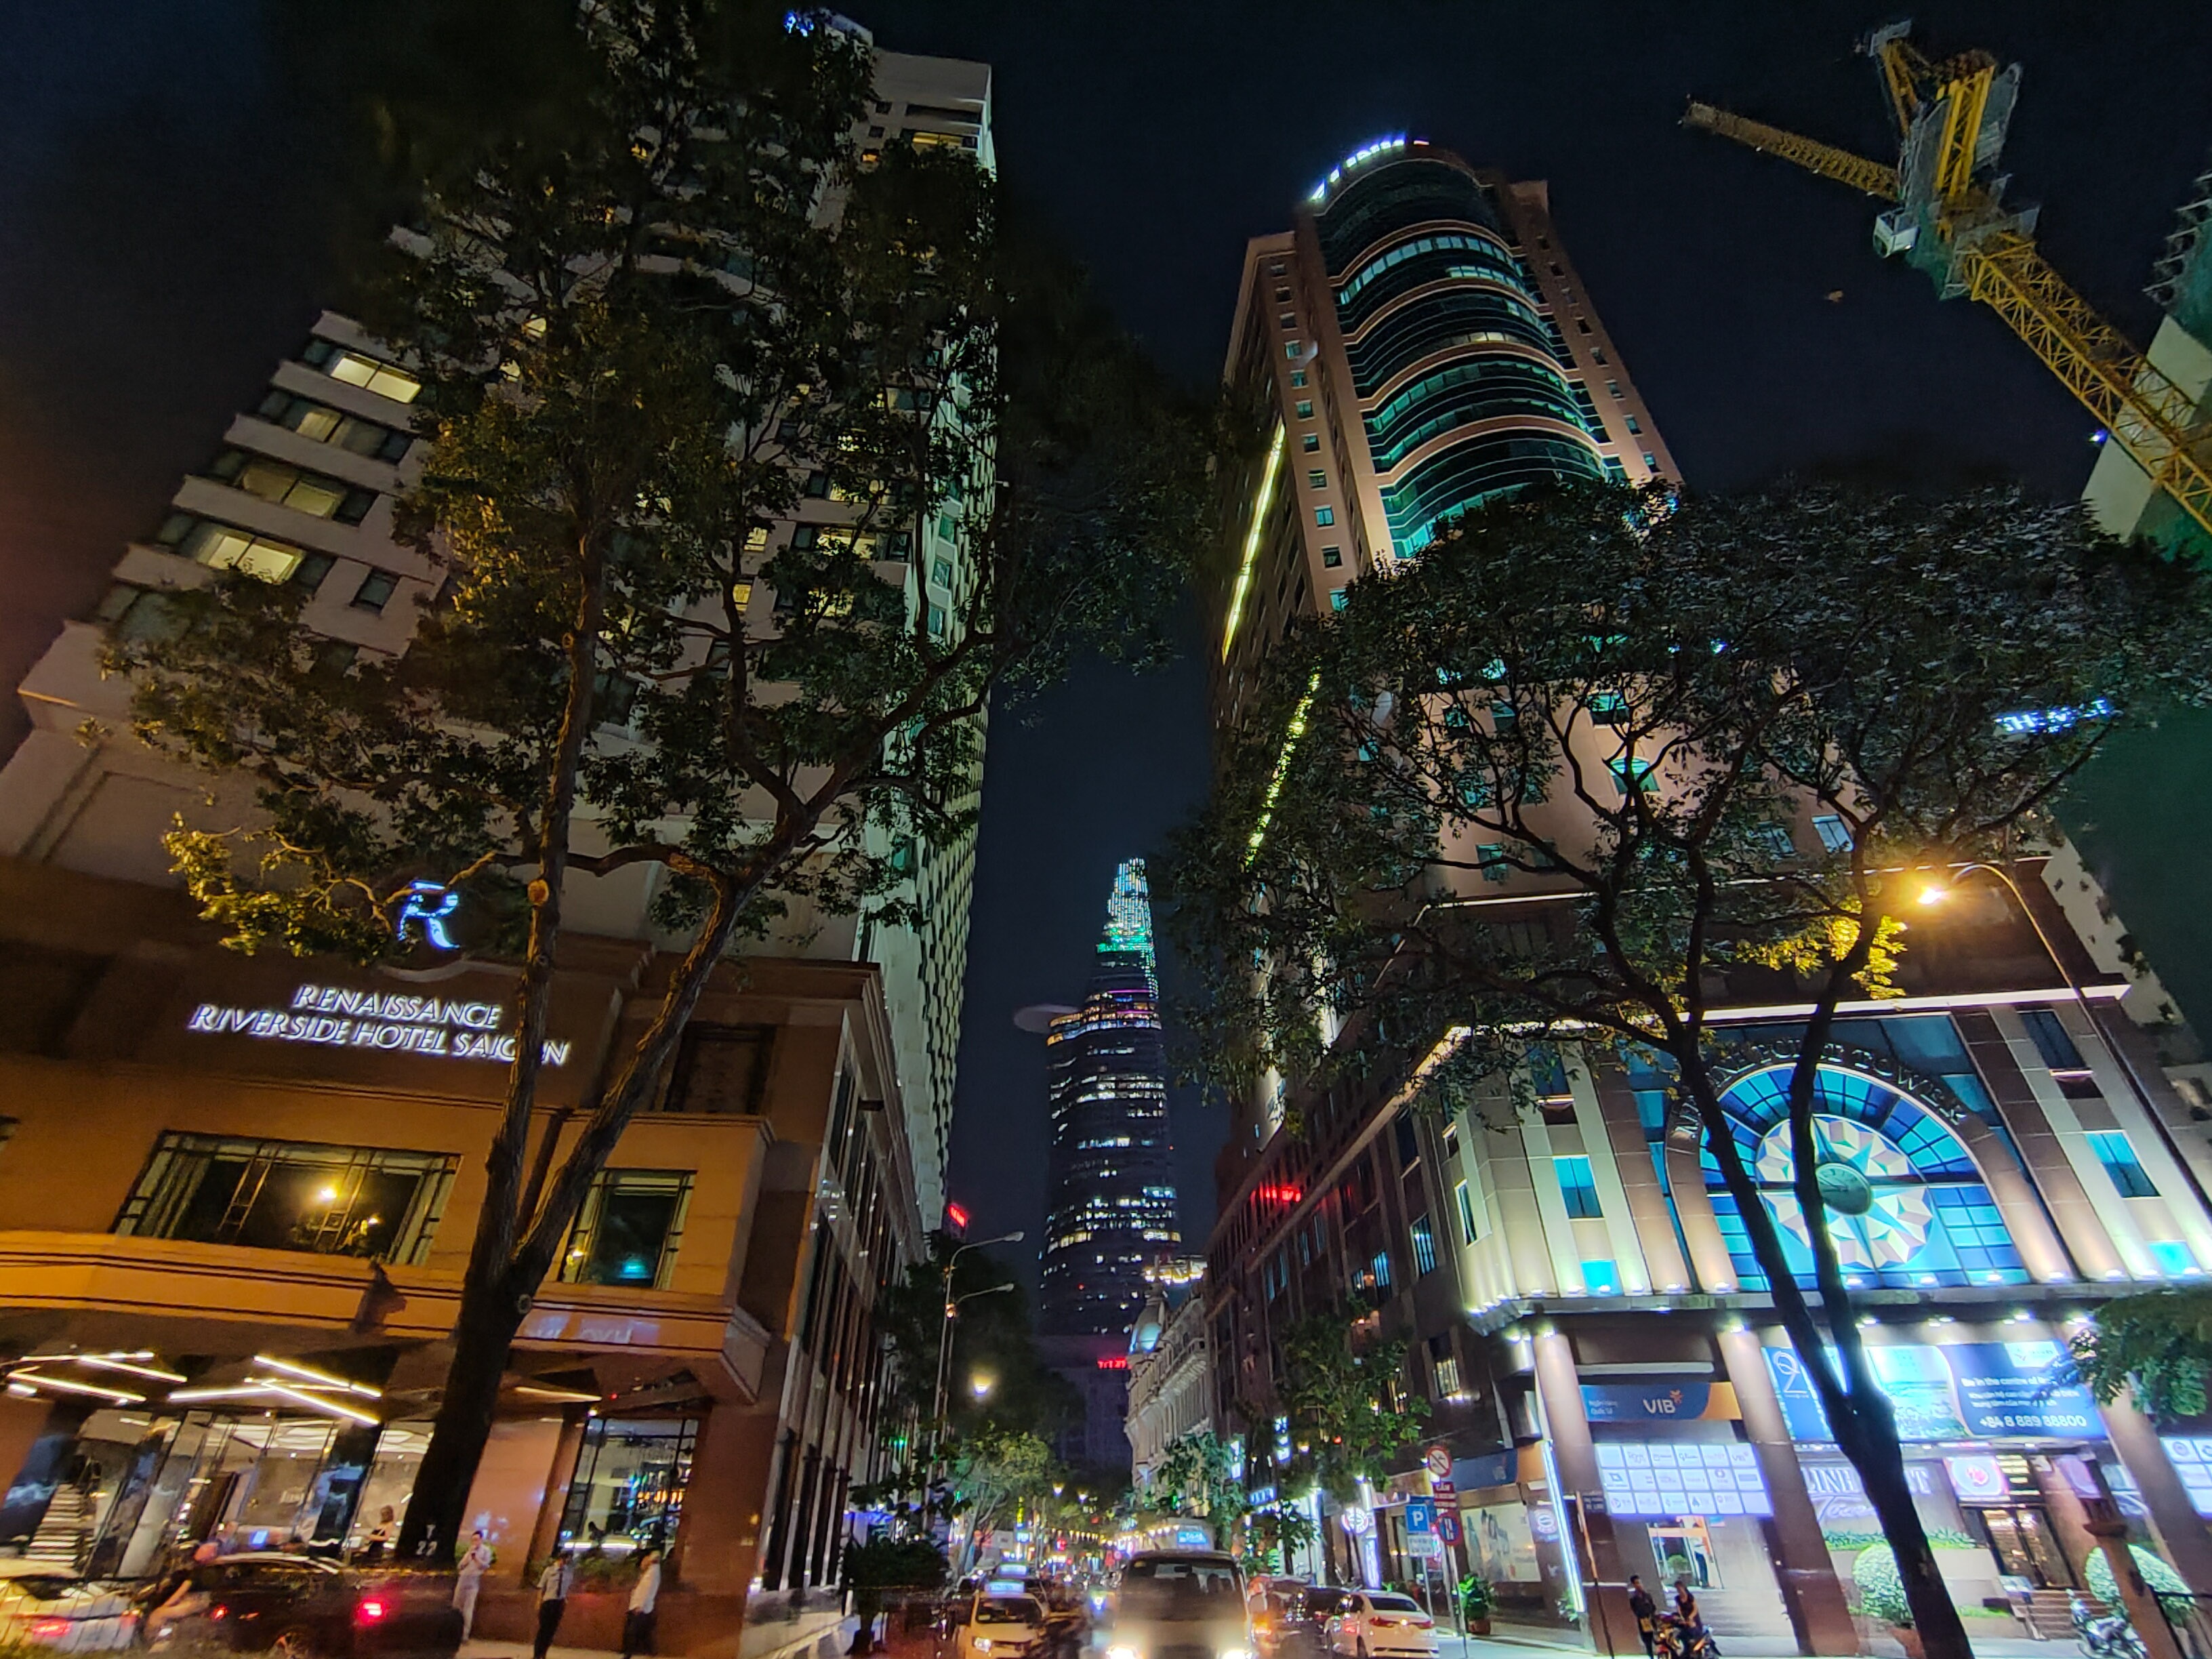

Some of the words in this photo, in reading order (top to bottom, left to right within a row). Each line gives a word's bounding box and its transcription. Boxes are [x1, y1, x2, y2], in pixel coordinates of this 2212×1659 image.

[291, 984, 501, 1029] RENAISSANCE
[188, 1004, 350, 1044] RIVERSIDE
[350, 1021, 447, 1054] HOTEL
[1643, 1399, 1676, 1414] VIB
[2003, 1415, 2015, 1427] 8
[1412, 1511, 1424, 1527] P
